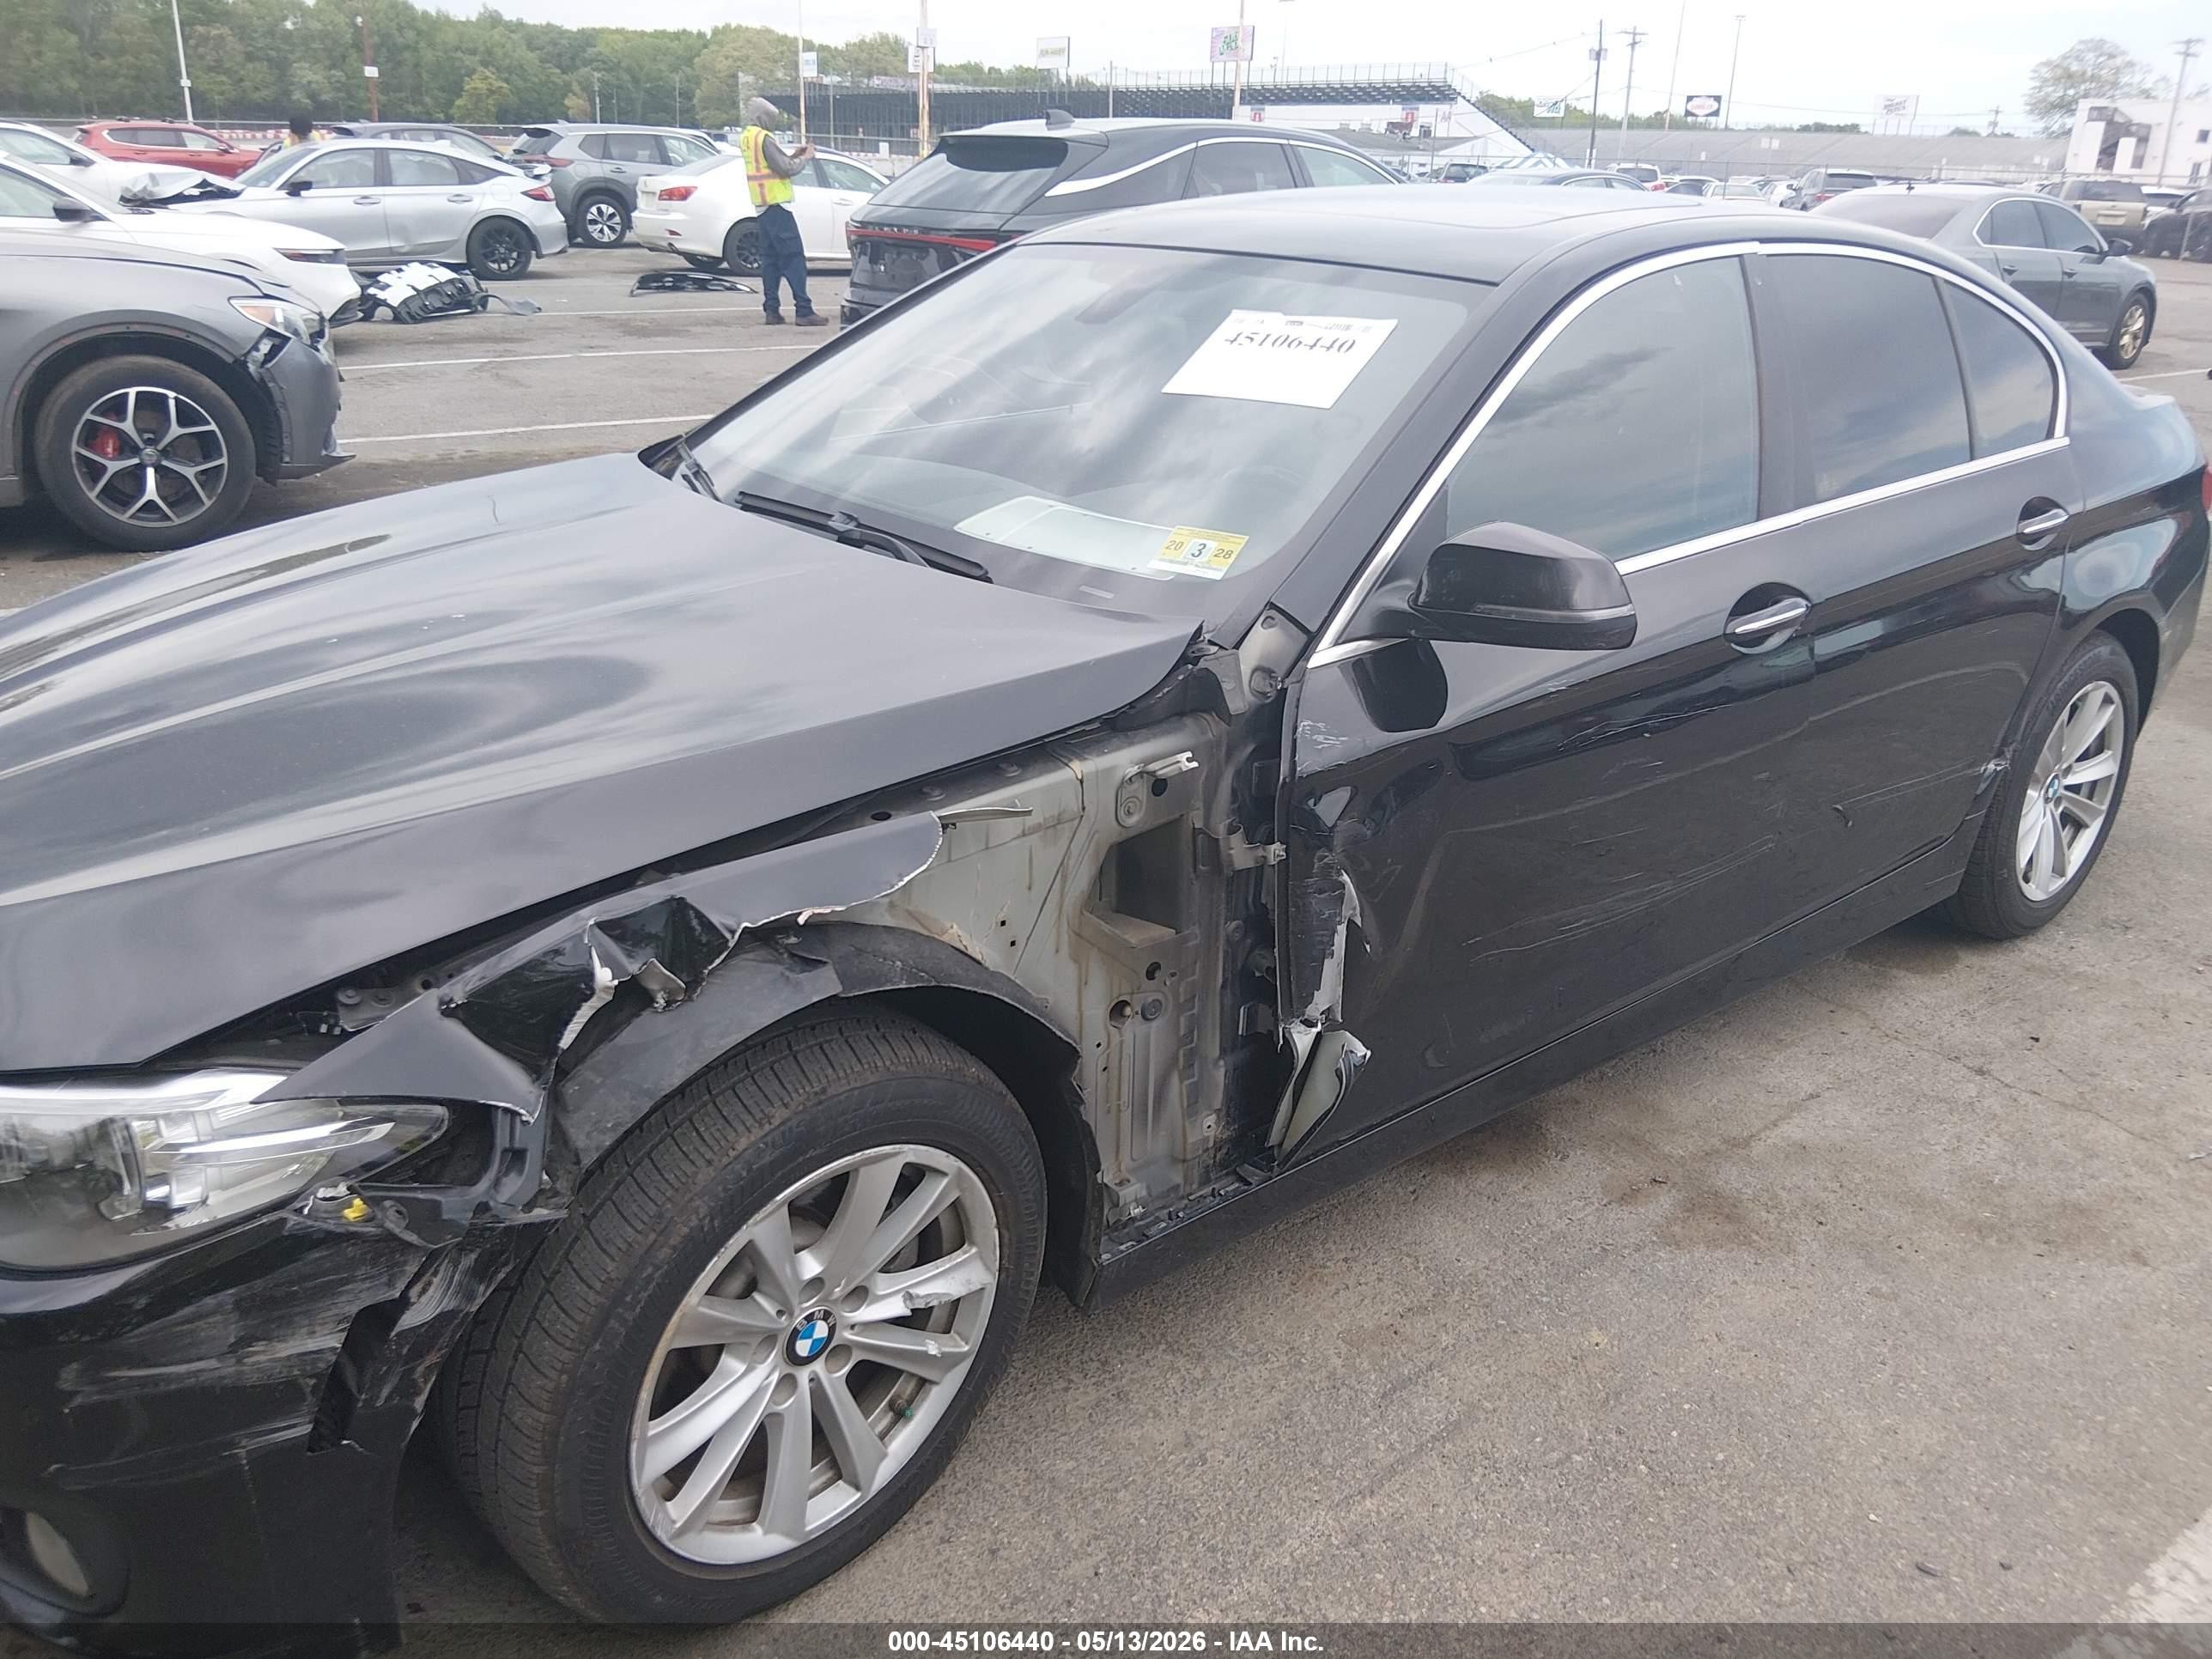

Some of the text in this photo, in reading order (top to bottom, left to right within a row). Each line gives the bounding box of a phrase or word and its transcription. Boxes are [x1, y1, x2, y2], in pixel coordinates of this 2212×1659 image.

[1224, 331, 1356, 354] 45106440
[1165, 540, 1234, 560] 20 3 28
[796, 1310, 836, 1330] BMW
